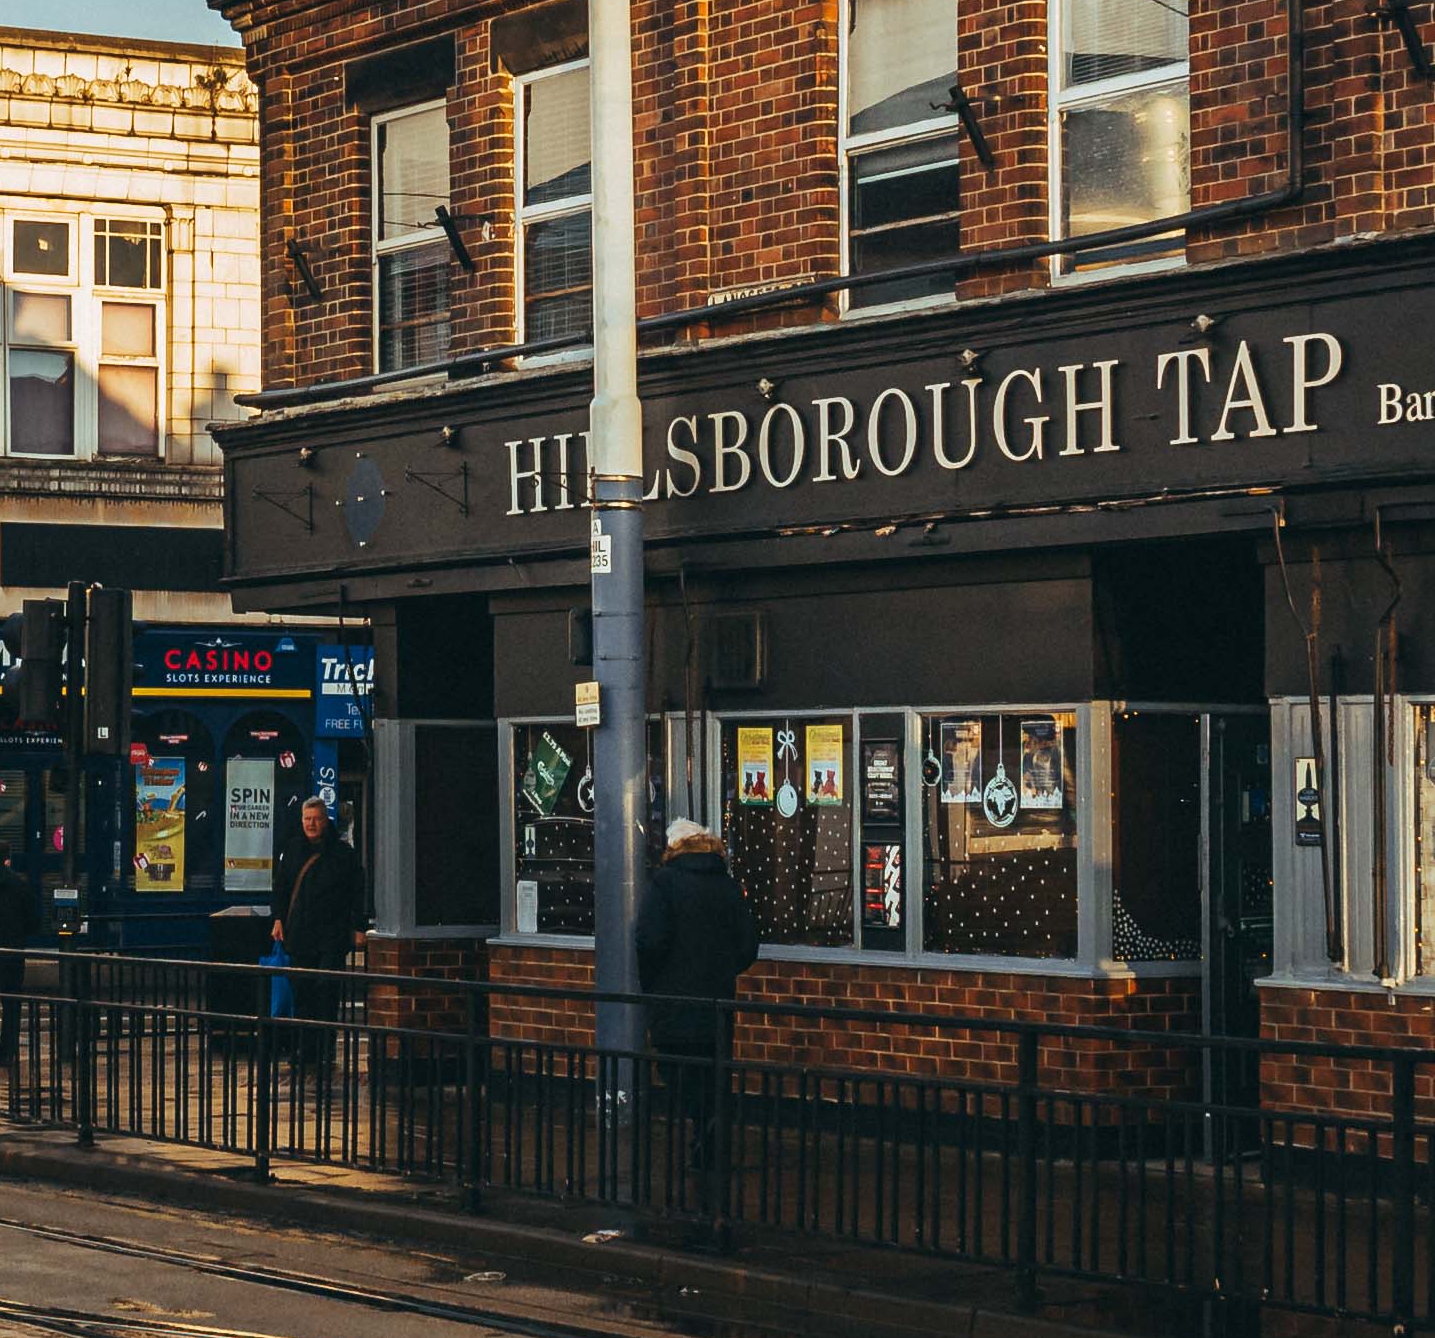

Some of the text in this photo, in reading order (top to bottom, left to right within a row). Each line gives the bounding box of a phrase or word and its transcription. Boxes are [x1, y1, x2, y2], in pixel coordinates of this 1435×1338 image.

[504, 356, 1122, 518] HISBOROUGH
[1156, 331, 1344, 446] TAP
[164, 649, 273, 671] CASINO
[166, 674, 272, 684] SLOTS EXPERIENCE
[324, 718, 349, 730] FREE
[0, 736, 63, 744] SLOTS EXPERIEN
[231, 788, 271, 804] SPIN
[230, 812, 269, 821] IN A NEW
[230, 821, 270, 829] DIRECTION
